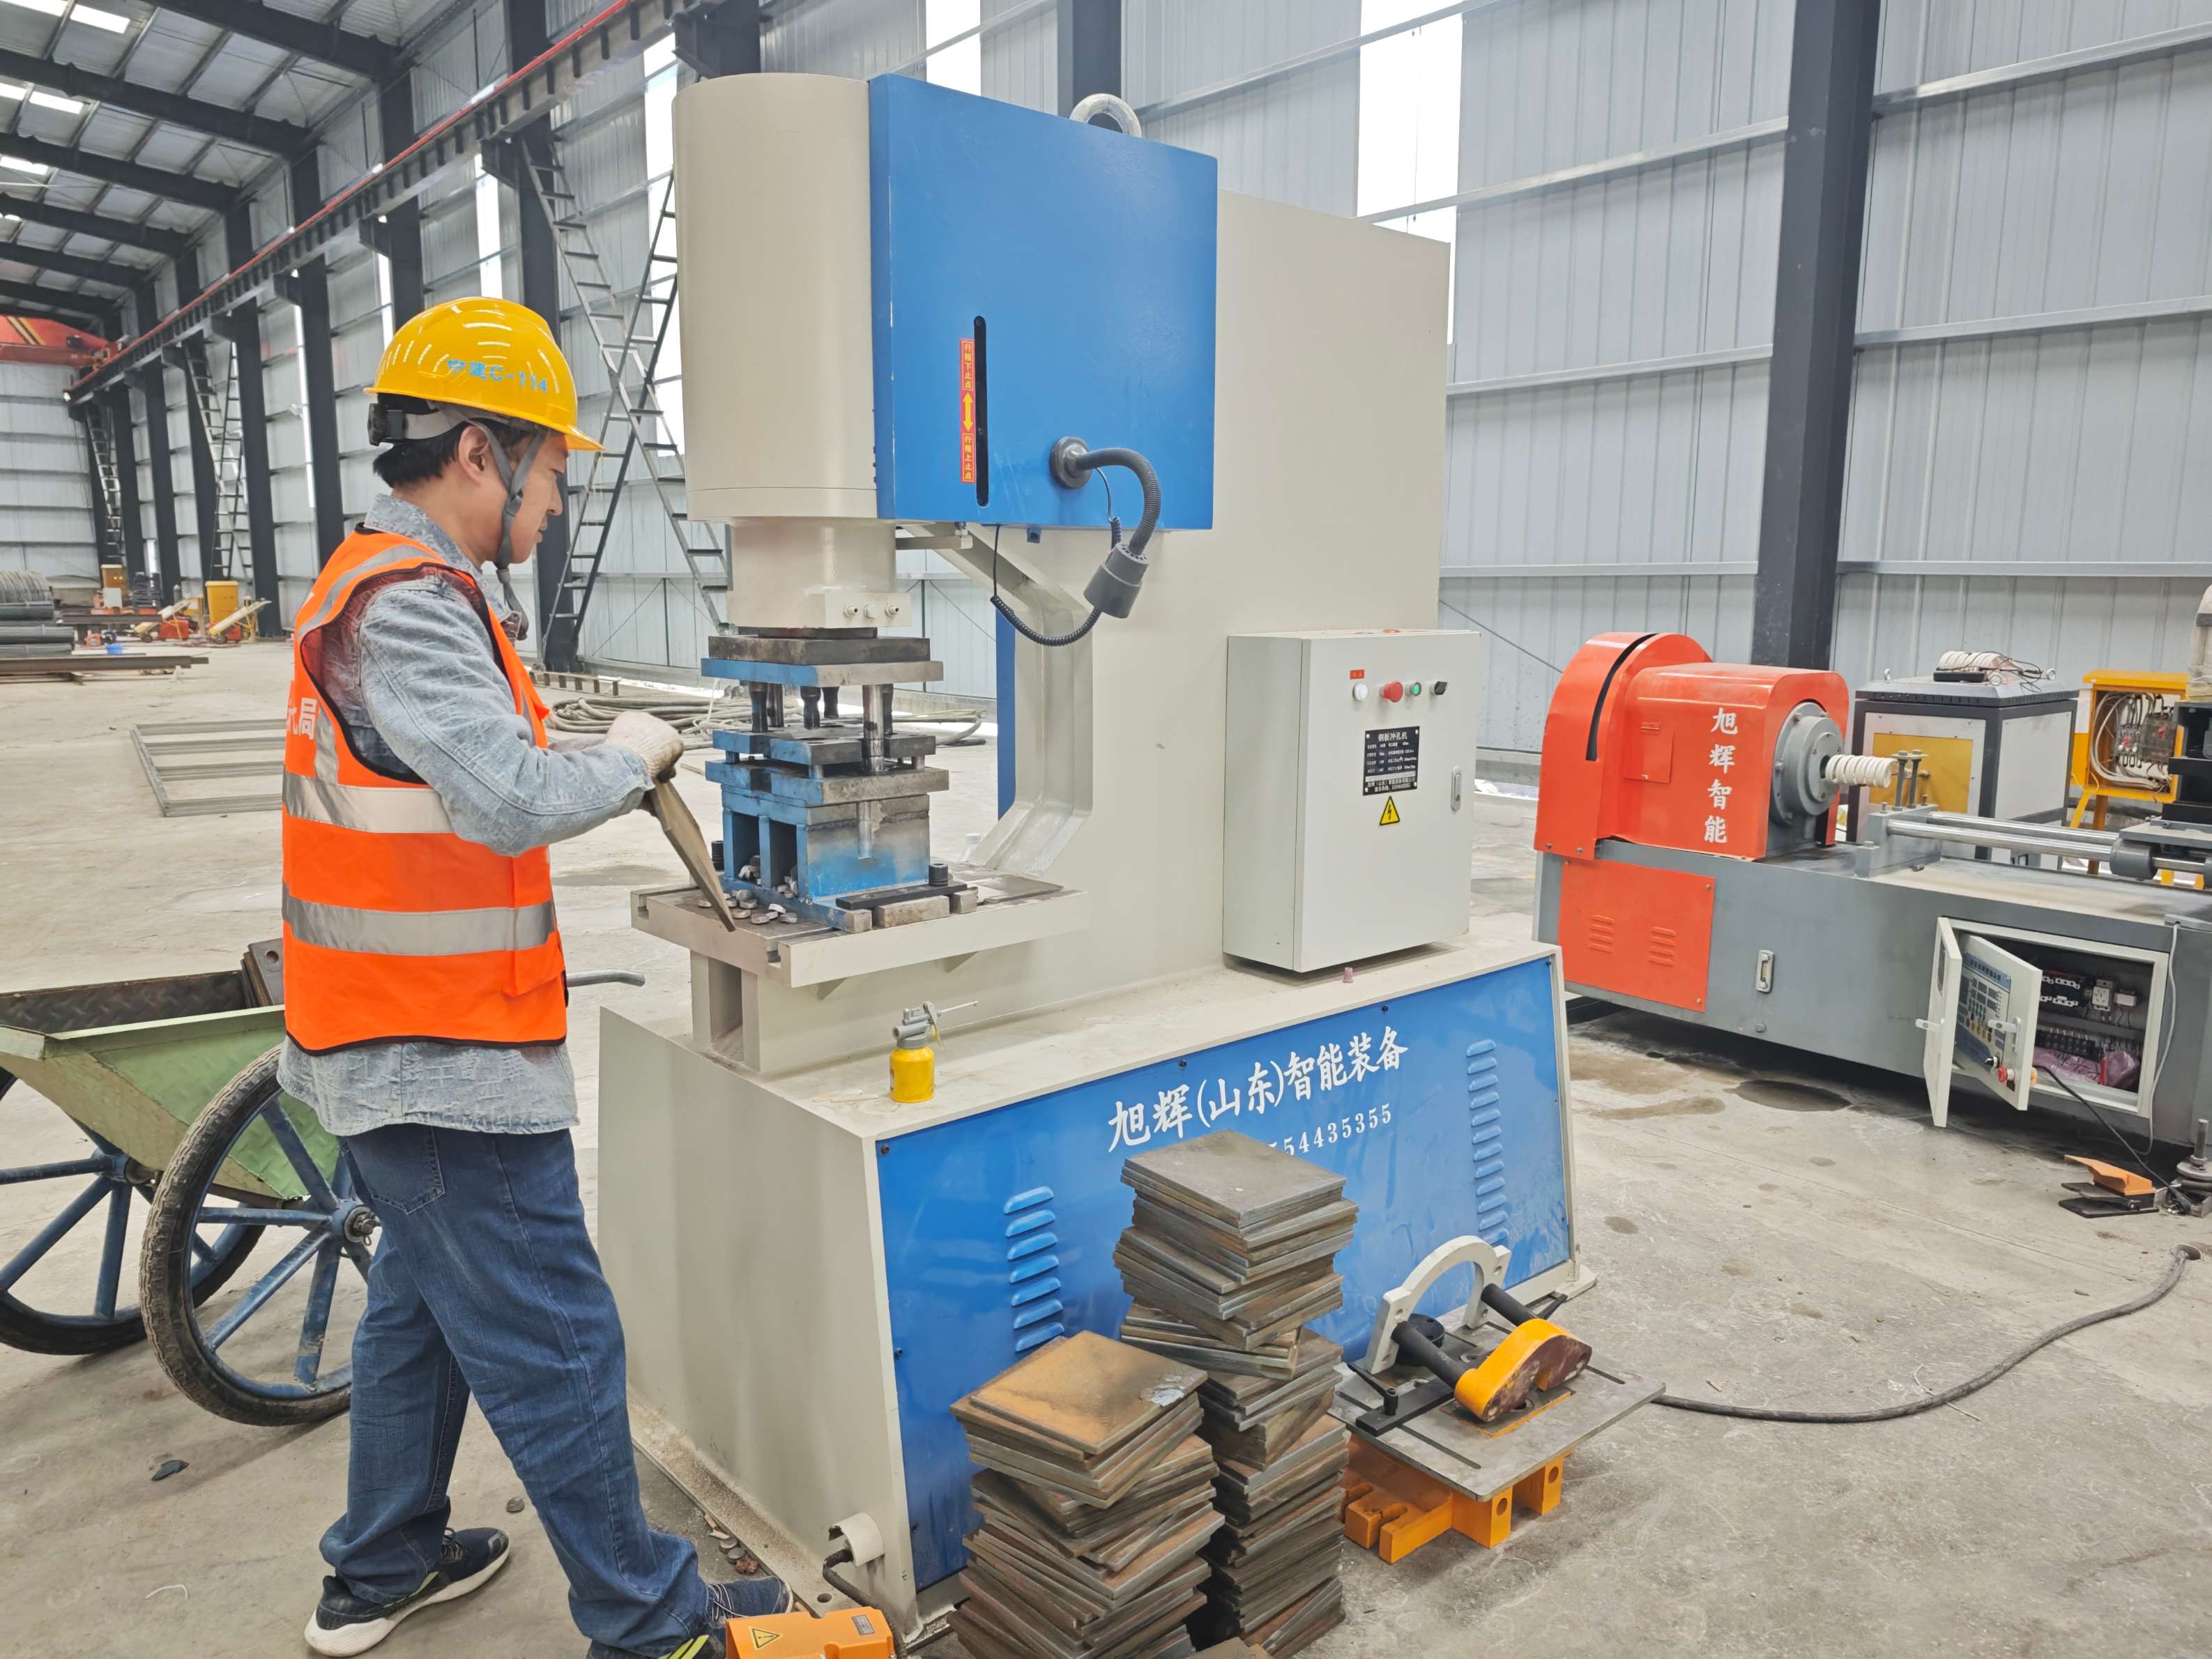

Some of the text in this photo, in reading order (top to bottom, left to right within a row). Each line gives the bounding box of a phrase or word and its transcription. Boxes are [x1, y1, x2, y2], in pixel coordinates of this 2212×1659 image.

[1704, 707, 1738, 843] 旭辉智能
[1269, 1103, 1391, 1156] 54435355
